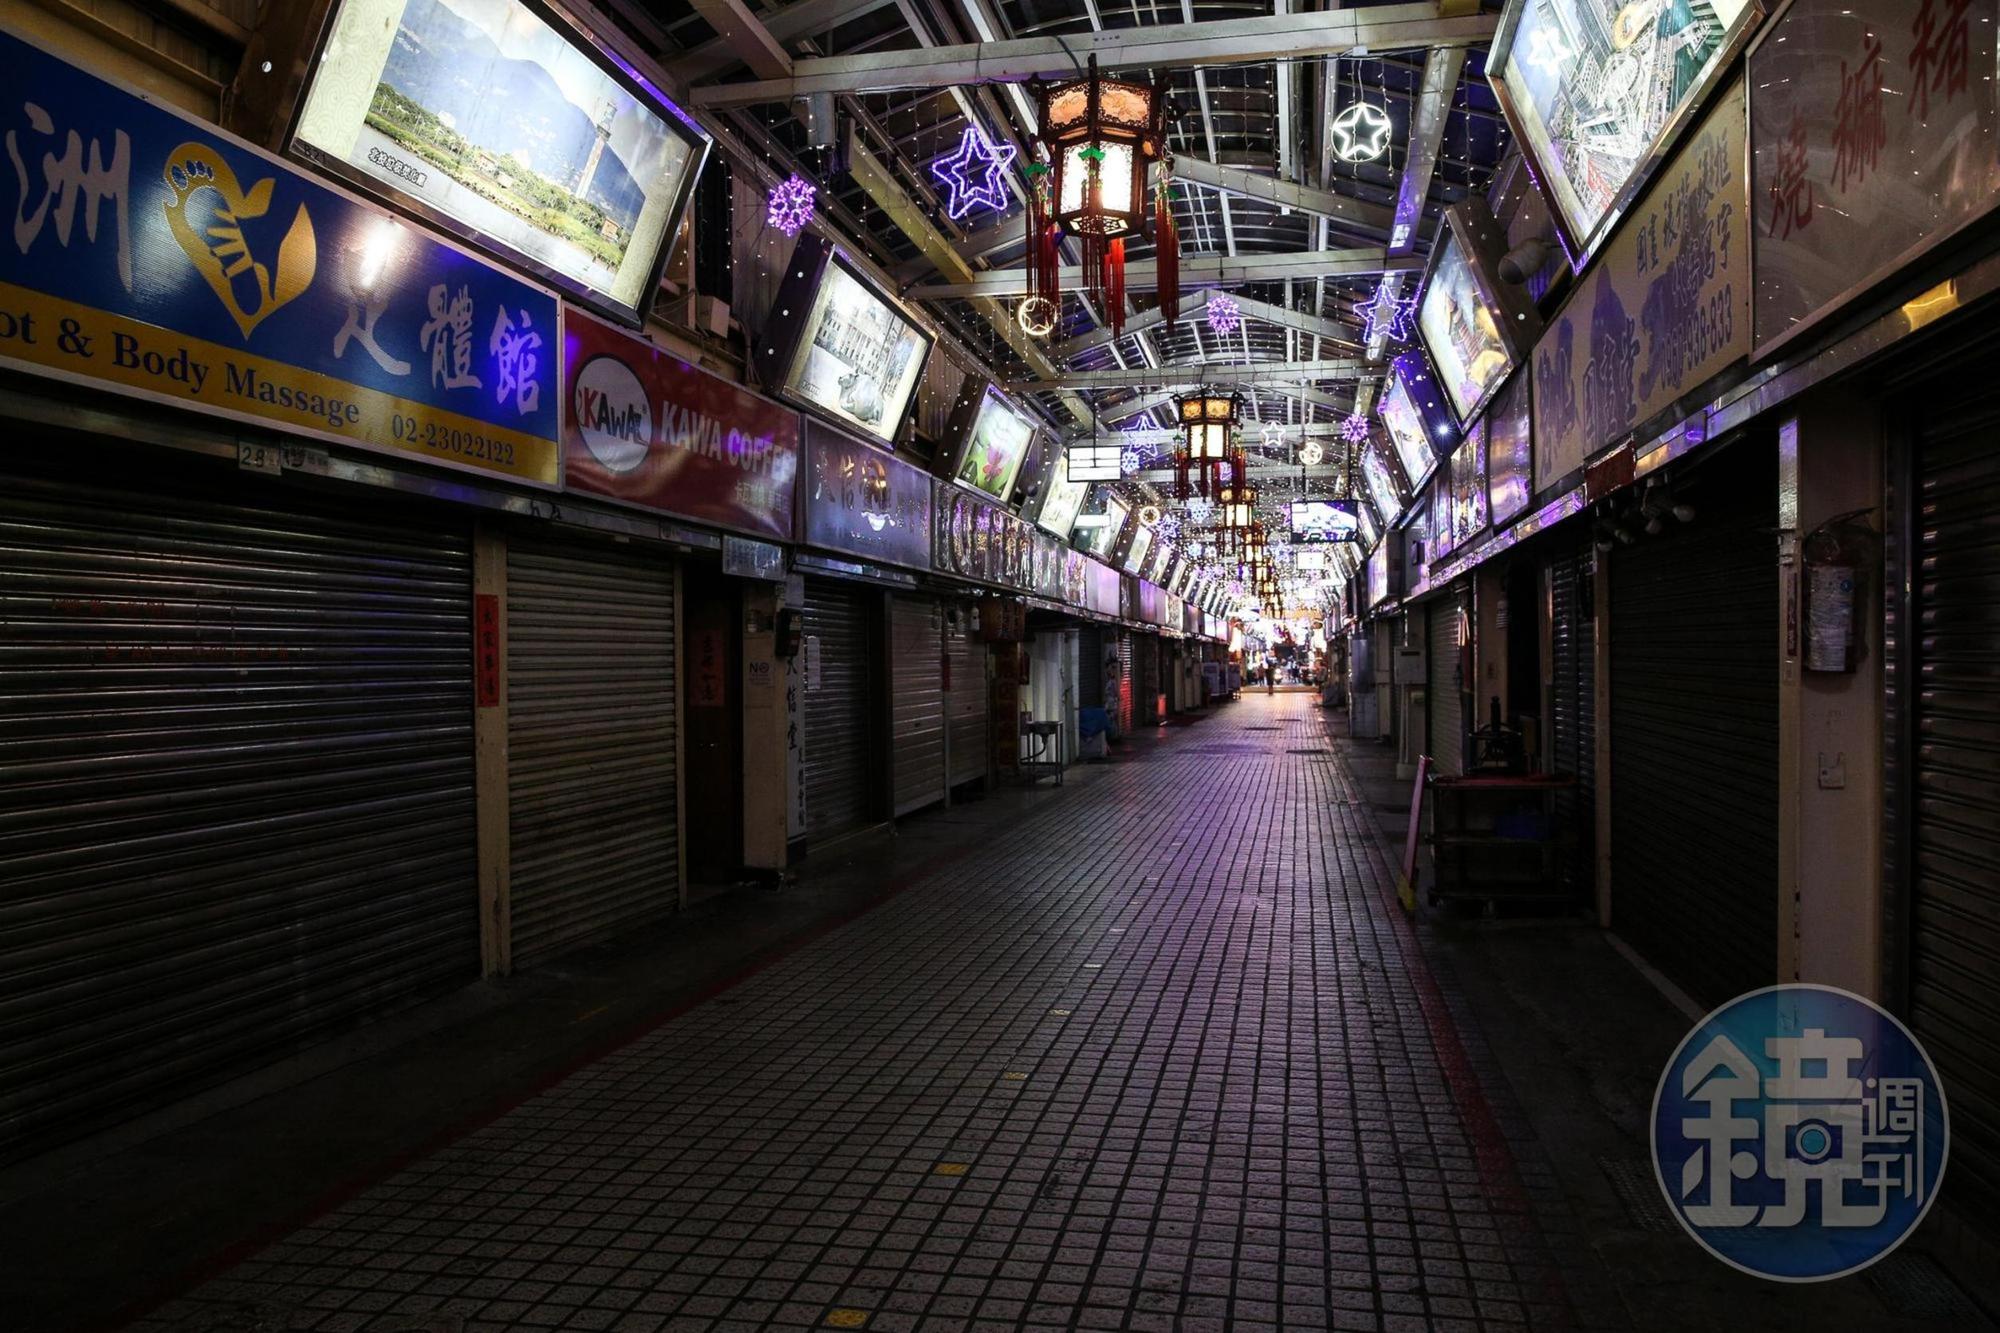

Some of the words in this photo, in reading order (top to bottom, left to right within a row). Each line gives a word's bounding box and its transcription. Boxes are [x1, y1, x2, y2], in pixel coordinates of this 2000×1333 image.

[58, 318, 93, 357] &
[112, 331, 210, 394] Body
[225, 361, 361, 428] Massage
[392, 414, 516, 466] 02-23022122
[661, 399, 723, 462] KAWA
